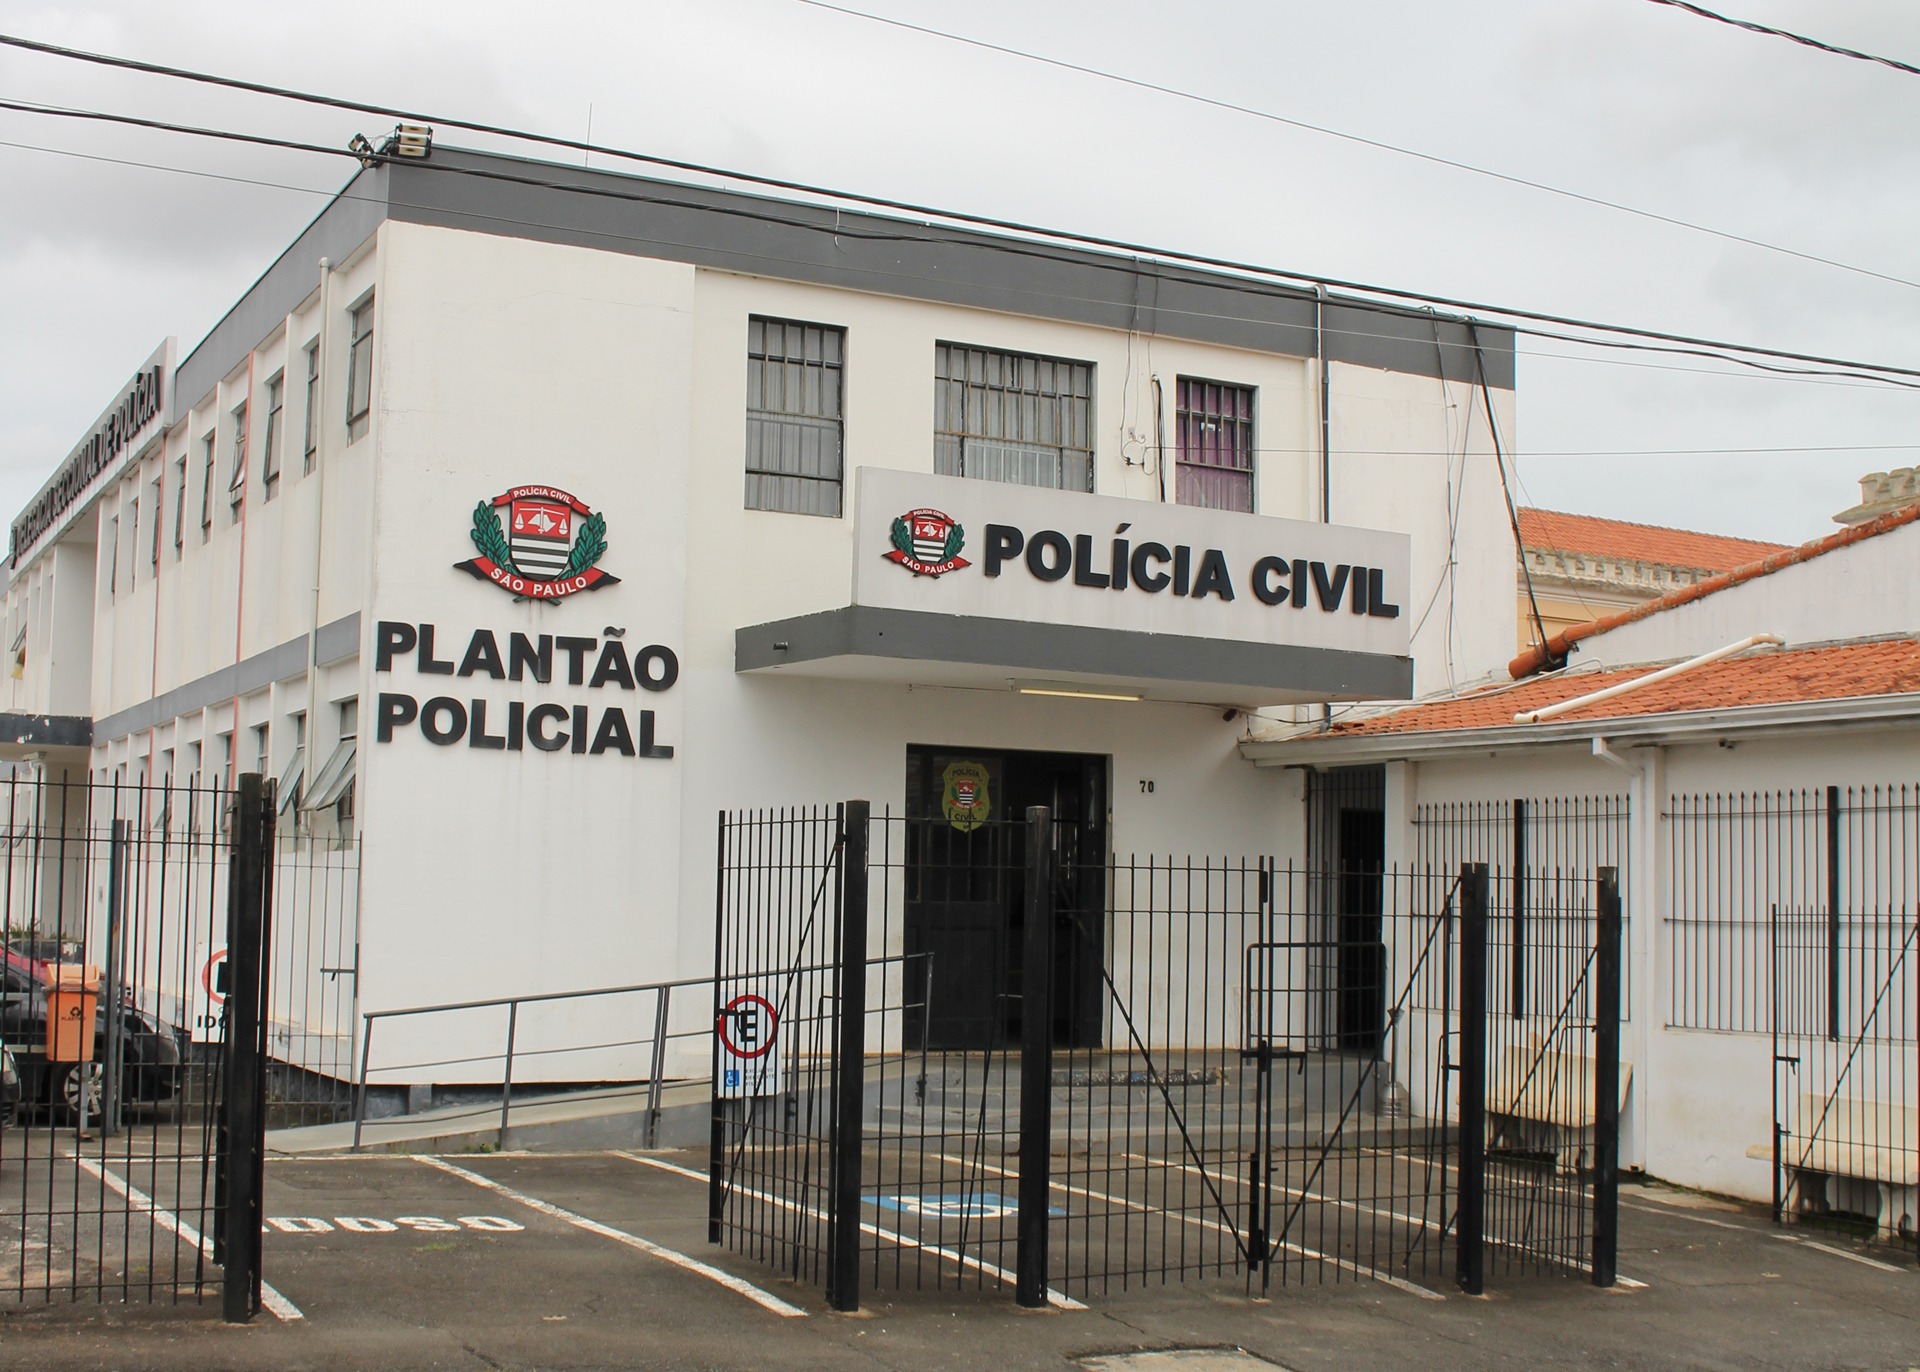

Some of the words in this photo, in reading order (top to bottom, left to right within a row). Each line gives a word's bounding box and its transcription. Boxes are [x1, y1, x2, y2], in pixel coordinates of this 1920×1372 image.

[100, 413, 115, 470] DE
[114, 364, 162, 453] POLÍCIA
[513, 486, 549, 498] POLÍCIA
[550, 490, 572, 505] CIVIL
[490, 567, 524, 591] SÃO
[533, 576, 587, 596] PAULO
[924, 561, 955, 574] PAULO
[984, 522, 1235, 602] POLÍCIA
[1252, 555, 1401, 619] CIVIL
[376, 620, 679, 692] PLANTÃO
[377, 692, 674, 759] POLICIAL
[1139, 780, 1154, 793] 70
[740, 1010, 758, 1042] E
